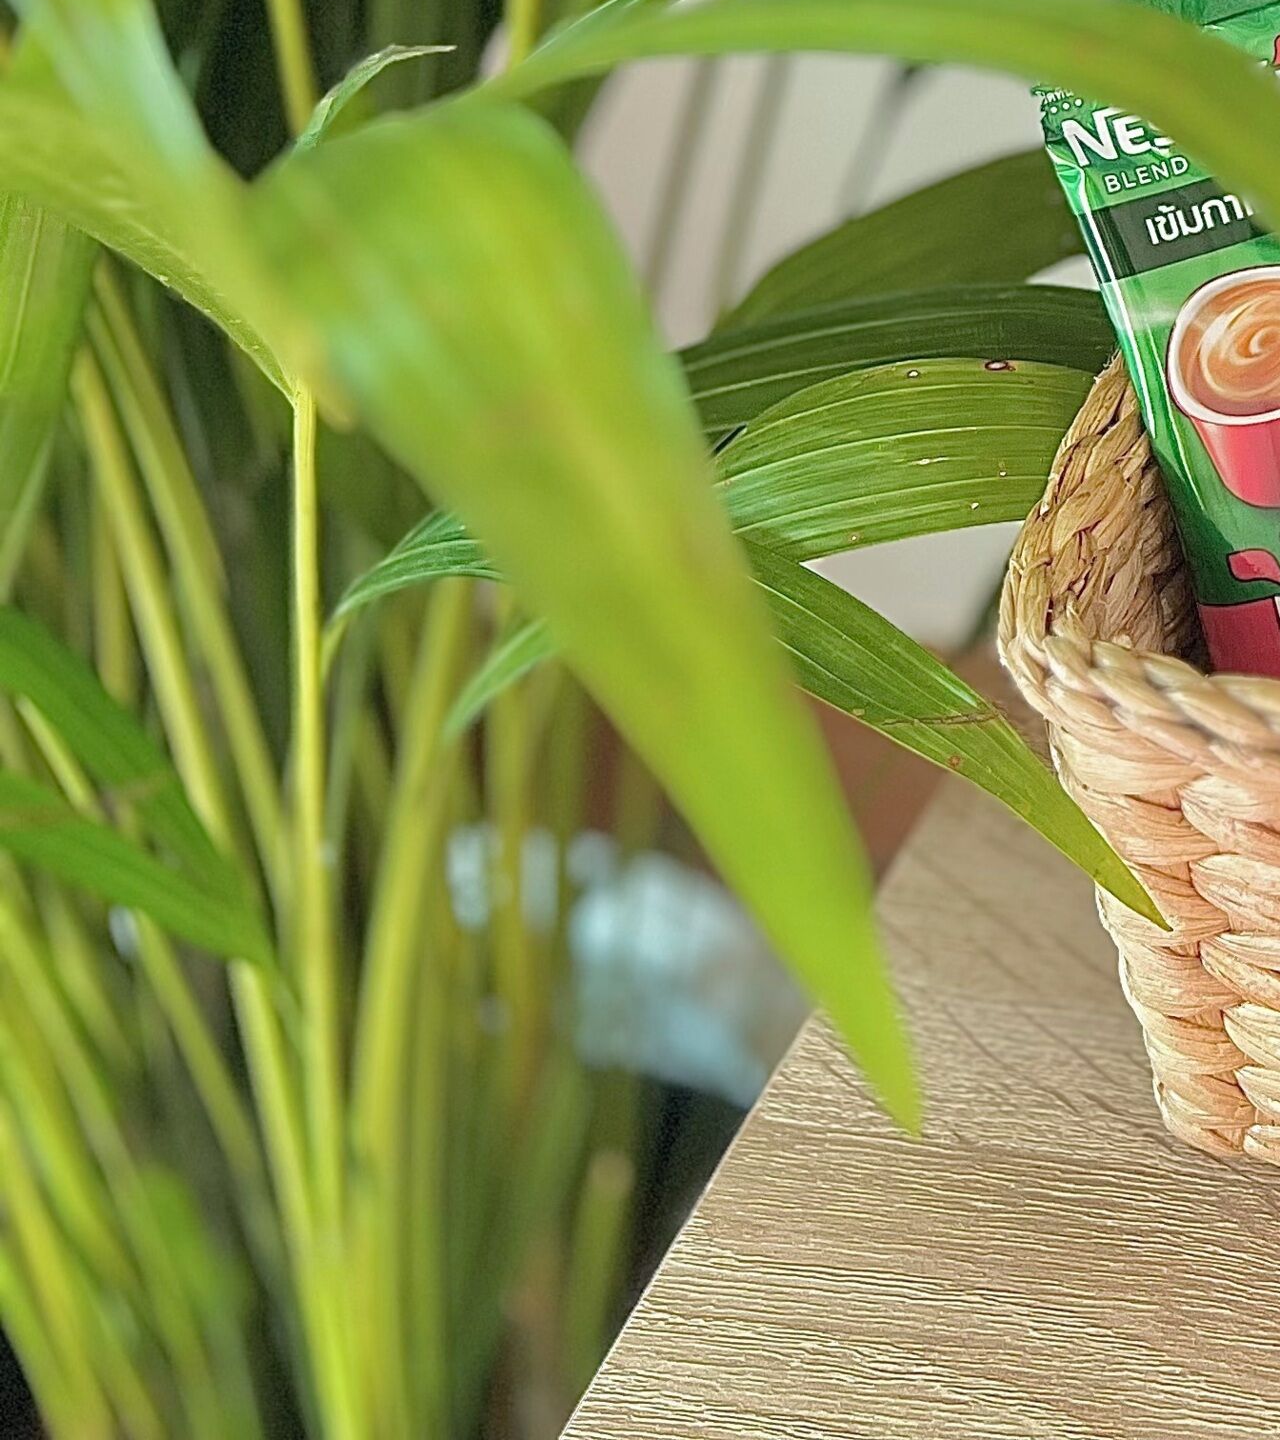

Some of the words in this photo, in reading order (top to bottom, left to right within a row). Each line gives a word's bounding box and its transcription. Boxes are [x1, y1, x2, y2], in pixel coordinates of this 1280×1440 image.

[1103, 156, 1189, 193] BLEND
[1145, 194, 1254, 245] เข้มกา
